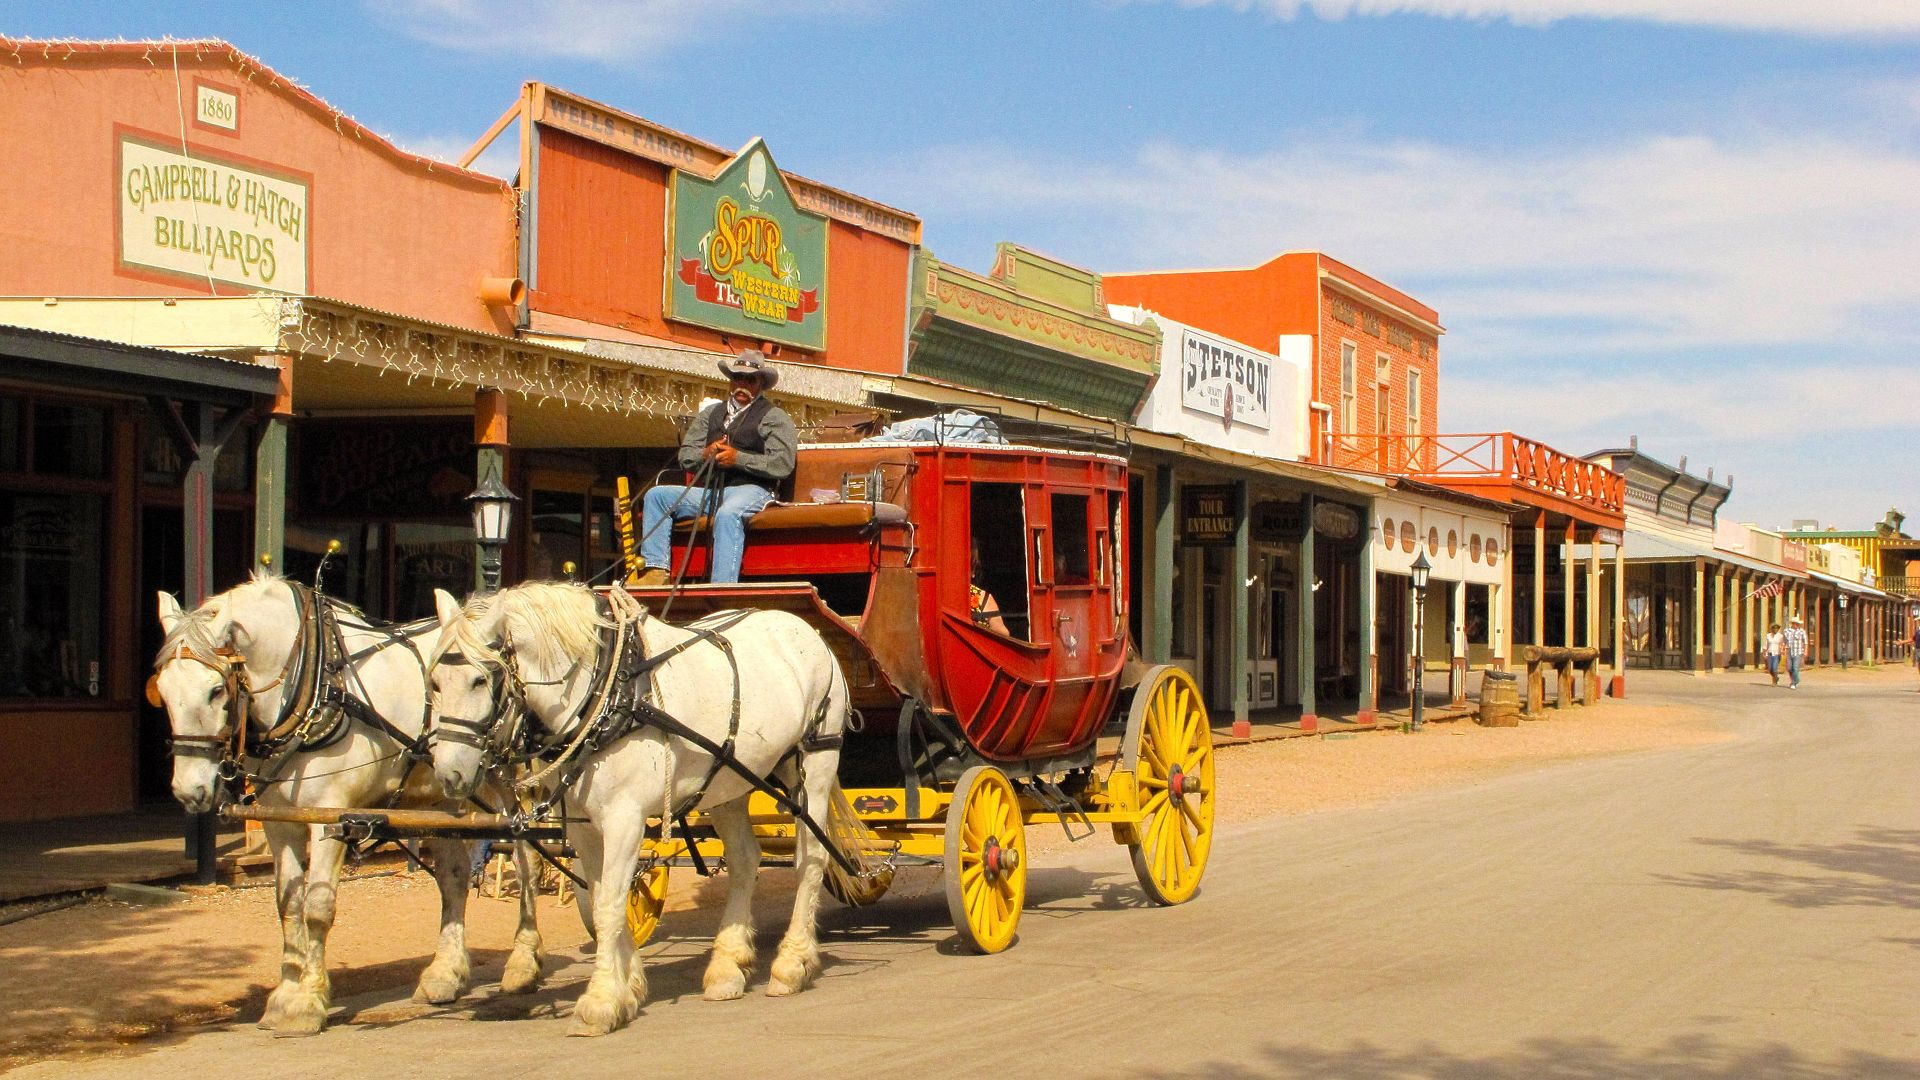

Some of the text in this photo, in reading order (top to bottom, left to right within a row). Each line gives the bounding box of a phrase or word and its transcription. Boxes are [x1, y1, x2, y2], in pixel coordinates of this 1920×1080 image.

[202, 95, 232, 121] 1880
[551, 98, 695, 163] WELLS FARGO
[127, 163, 302, 243] CAMPBELL & HATCH
[799, 185, 910, 237] EXPRESS OFFICE
[154, 216, 277, 283] BILLIARDS
[710, 201, 788, 279] SPUR
[732, 269, 799, 305] WESTERN
[743, 292, 785, 320] WEAR
[1187, 338, 1268, 414] STETSON
[1188, 517, 1234, 533] ENTRANCE
[1199, 500, 1224, 515] TOUR
[415, 559, 455, 577] ART
